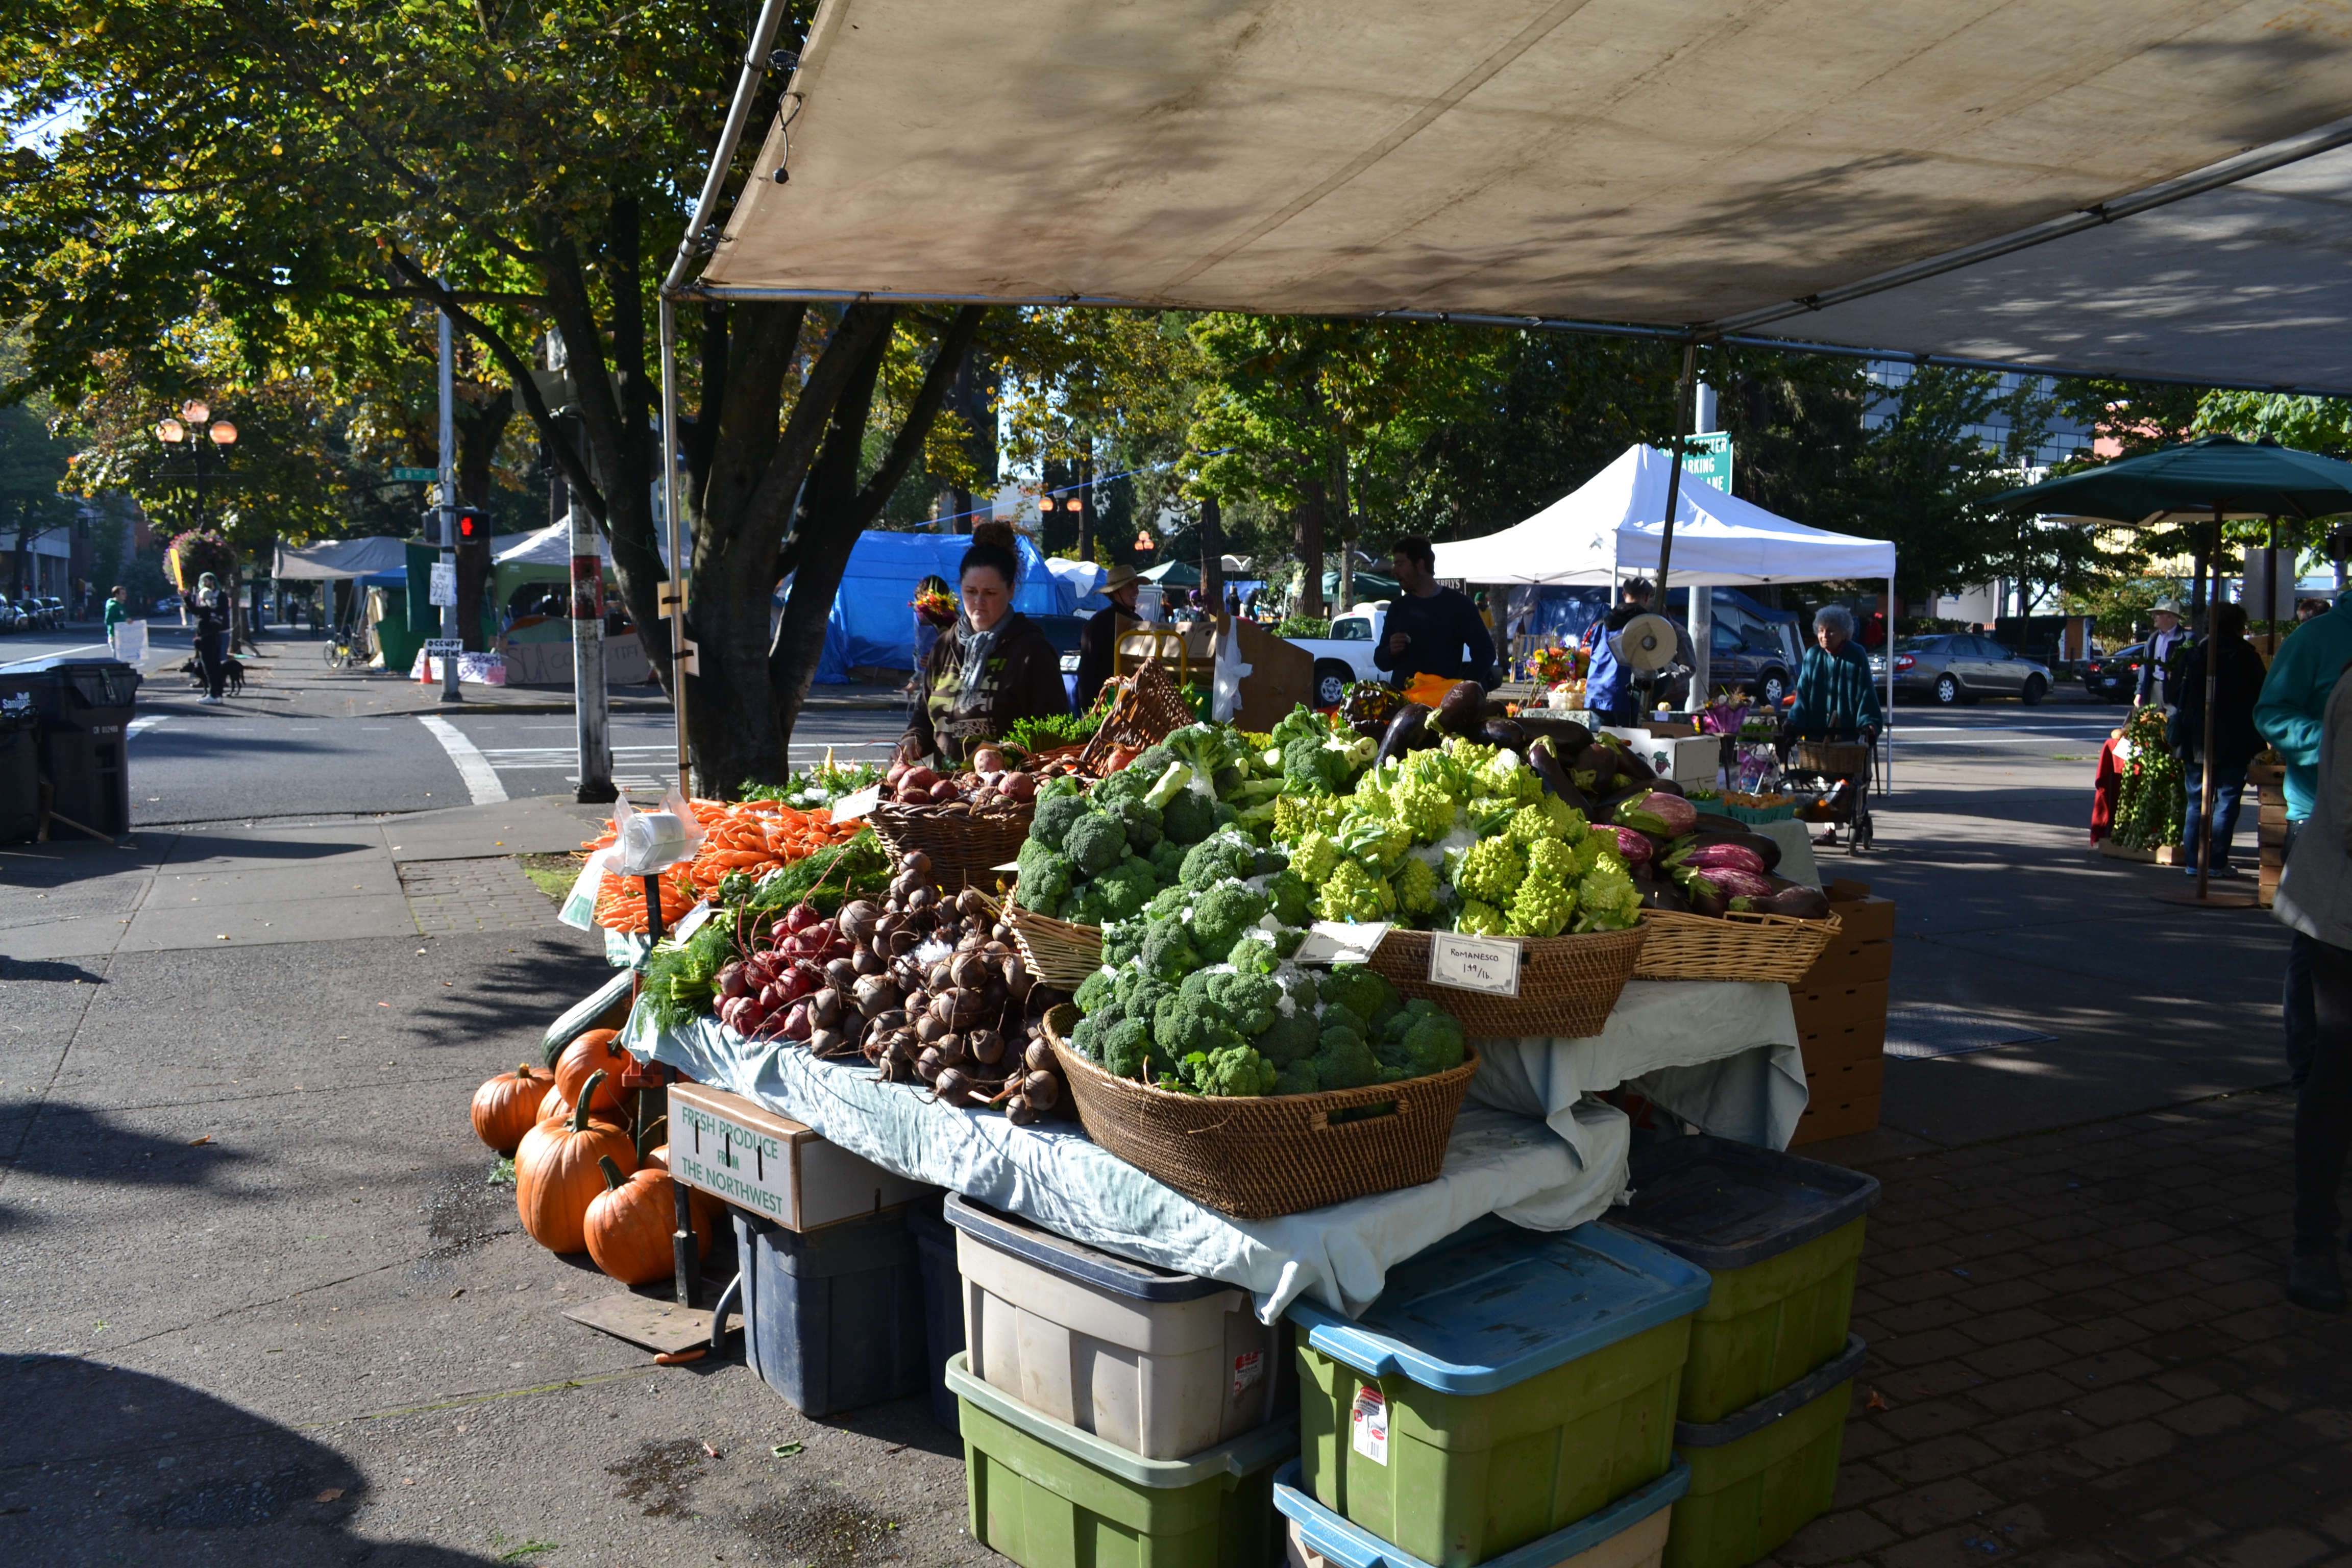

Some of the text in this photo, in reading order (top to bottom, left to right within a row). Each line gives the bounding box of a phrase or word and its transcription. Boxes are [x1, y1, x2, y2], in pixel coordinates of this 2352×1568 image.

[395, 470, 401, 478] E
[406, 470, 411, 478] 8
[1682, 457, 1715, 474] ARKING
[682, 1107, 778, 1160] FRESH PRODUCE
[681, 1157, 782, 1214] THE NORTHWEST
